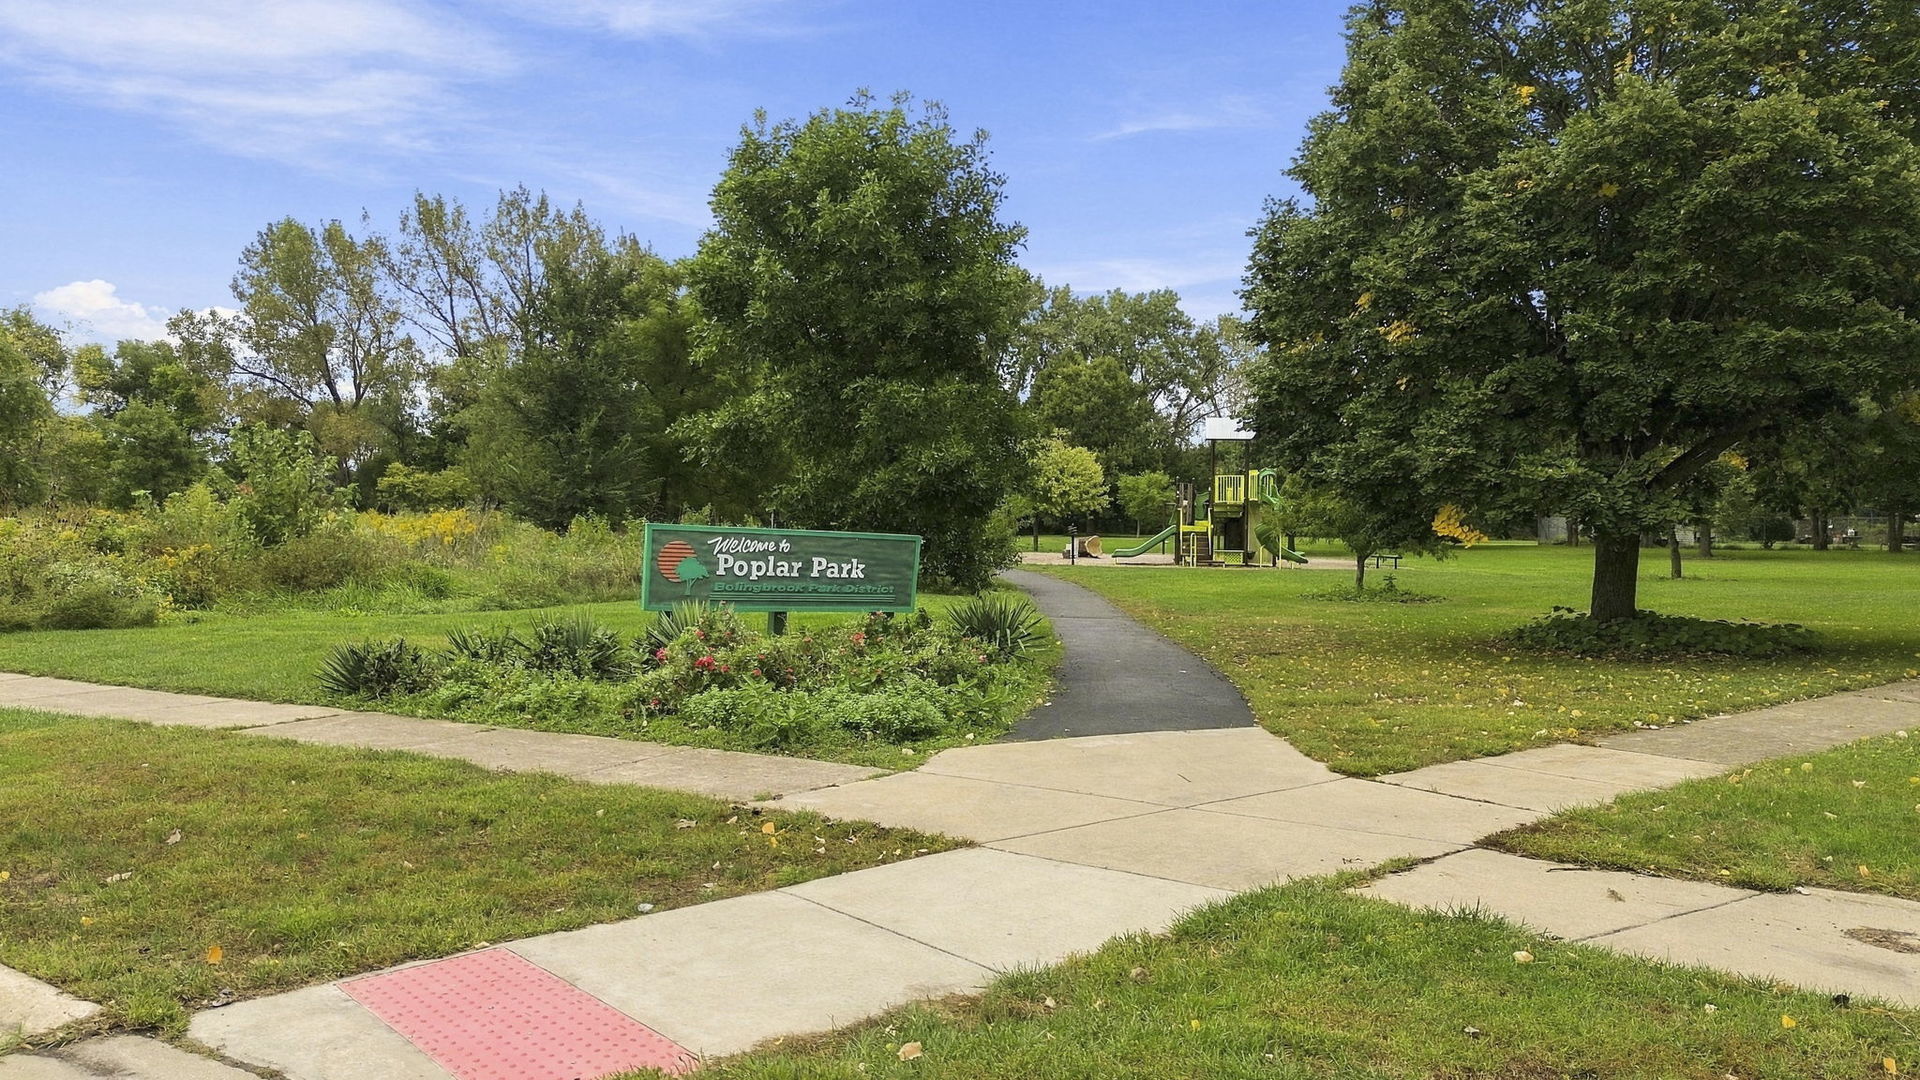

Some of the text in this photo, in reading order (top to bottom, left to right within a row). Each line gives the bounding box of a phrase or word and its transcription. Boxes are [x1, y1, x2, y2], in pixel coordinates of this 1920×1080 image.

[707, 536, 791, 554] Welcome to
[716, 554, 865, 580] Poplar Park
[714, 582, 895, 594] Bolingbrook Park District
